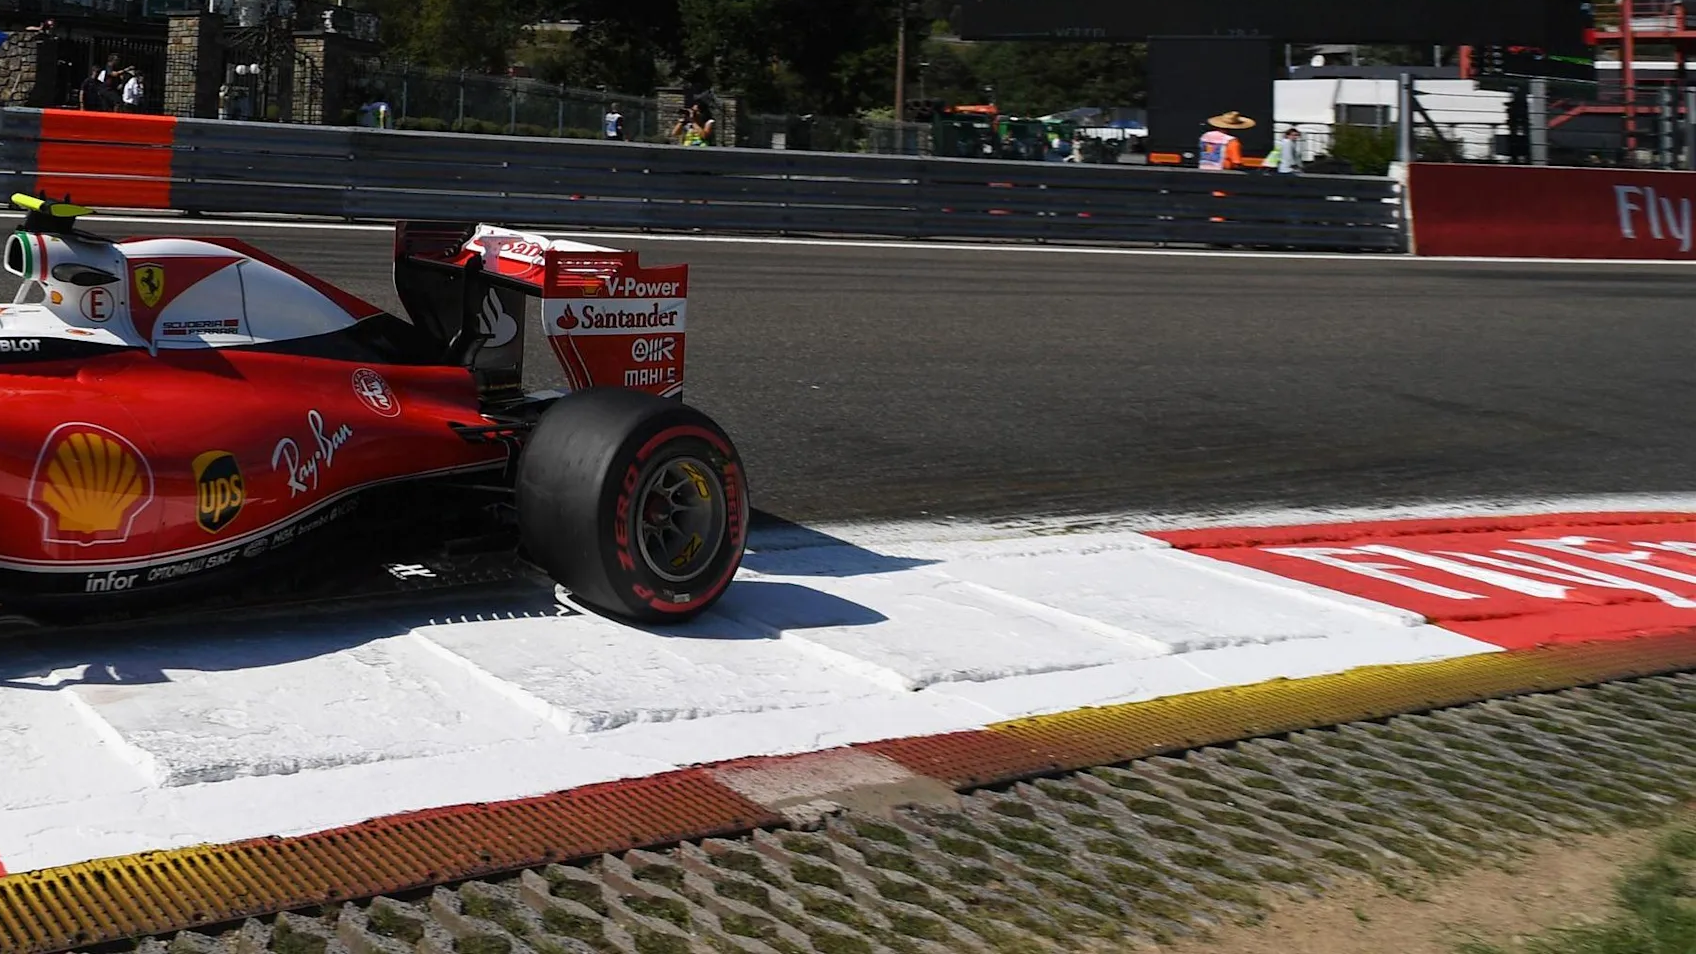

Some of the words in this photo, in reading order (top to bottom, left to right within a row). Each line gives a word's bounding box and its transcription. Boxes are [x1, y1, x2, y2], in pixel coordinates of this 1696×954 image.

[1613, 185, 1692, 252] Fly
[91, 290, 106, 319] E
[604, 277, 680, 297] V-Power
[581, 302, 678, 329] Santander
[201, 474, 242, 523] ups
[85, 571, 139, 592] infor
[205, 549, 240, 570] SKF
